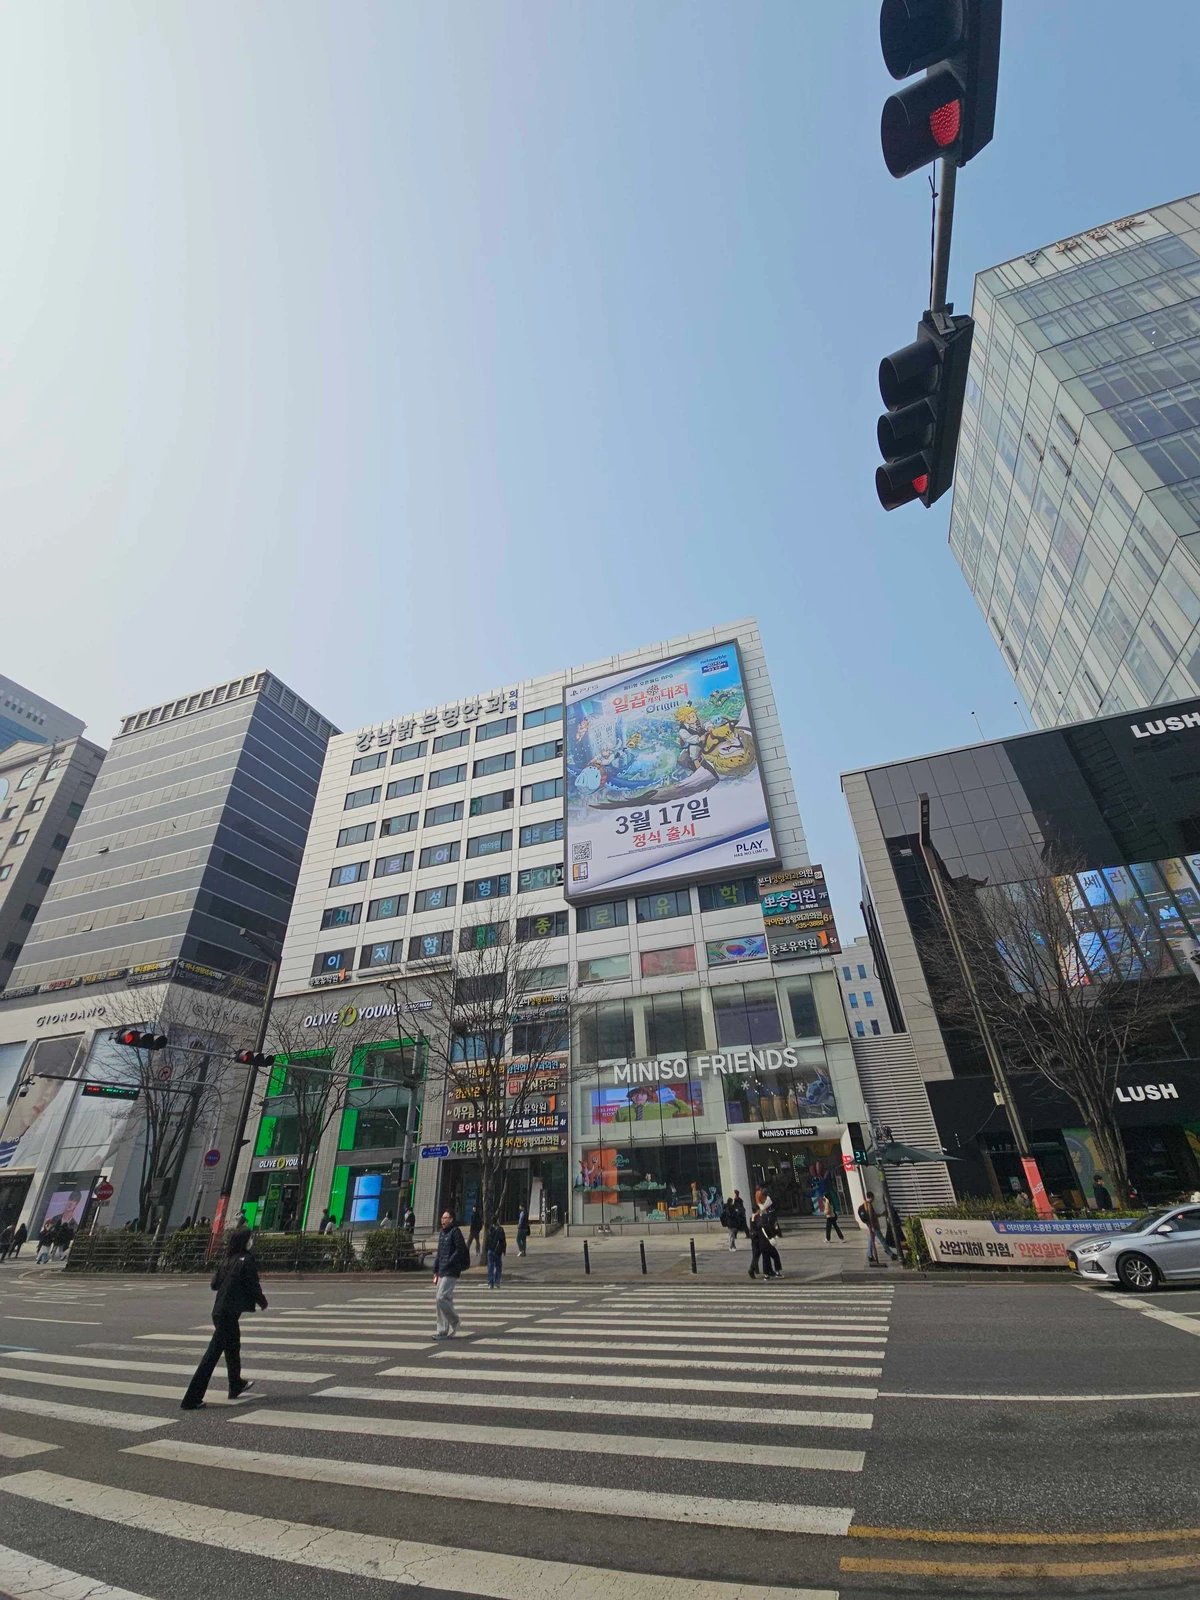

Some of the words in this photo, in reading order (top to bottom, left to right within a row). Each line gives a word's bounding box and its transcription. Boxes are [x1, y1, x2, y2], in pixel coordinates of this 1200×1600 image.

[612, 691, 647, 714] 일곱
[661, 682, 689, 700] 대죄
[1130, 712, 1200, 739] LUSH
[615, 810, 651, 834] 3월
[658, 796, 711, 824] 17일
[633, 831, 661, 848] 정식
[666, 823, 696, 841] 출시
[736, 839, 764, 852] PLAY
[770, 938, 817, 955] 종로유학원
[36, 1005, 106, 1028] GIORDANO
[304, 1012, 338, 1028] OLIVE
[359, 1002, 401, 1020] YOUNG
[614, 1057, 688, 1085] MINISO
[697, 1047, 799, 1077] FRIENDS
[1116, 1083, 1179, 1103] LUSH
[762, 1129, 785, 1138] MINISO
[785, 1127, 814, 1136] FRIENDS
[259, 1160, 276, 1169] OLIVE
[855, 1151, 867, 1162] 21
[1006, 1223, 1032, 1232] 여러분의
[939, 1240, 985, 1257] 산업재해
[986, 1241, 1014, 1259] 위험,
